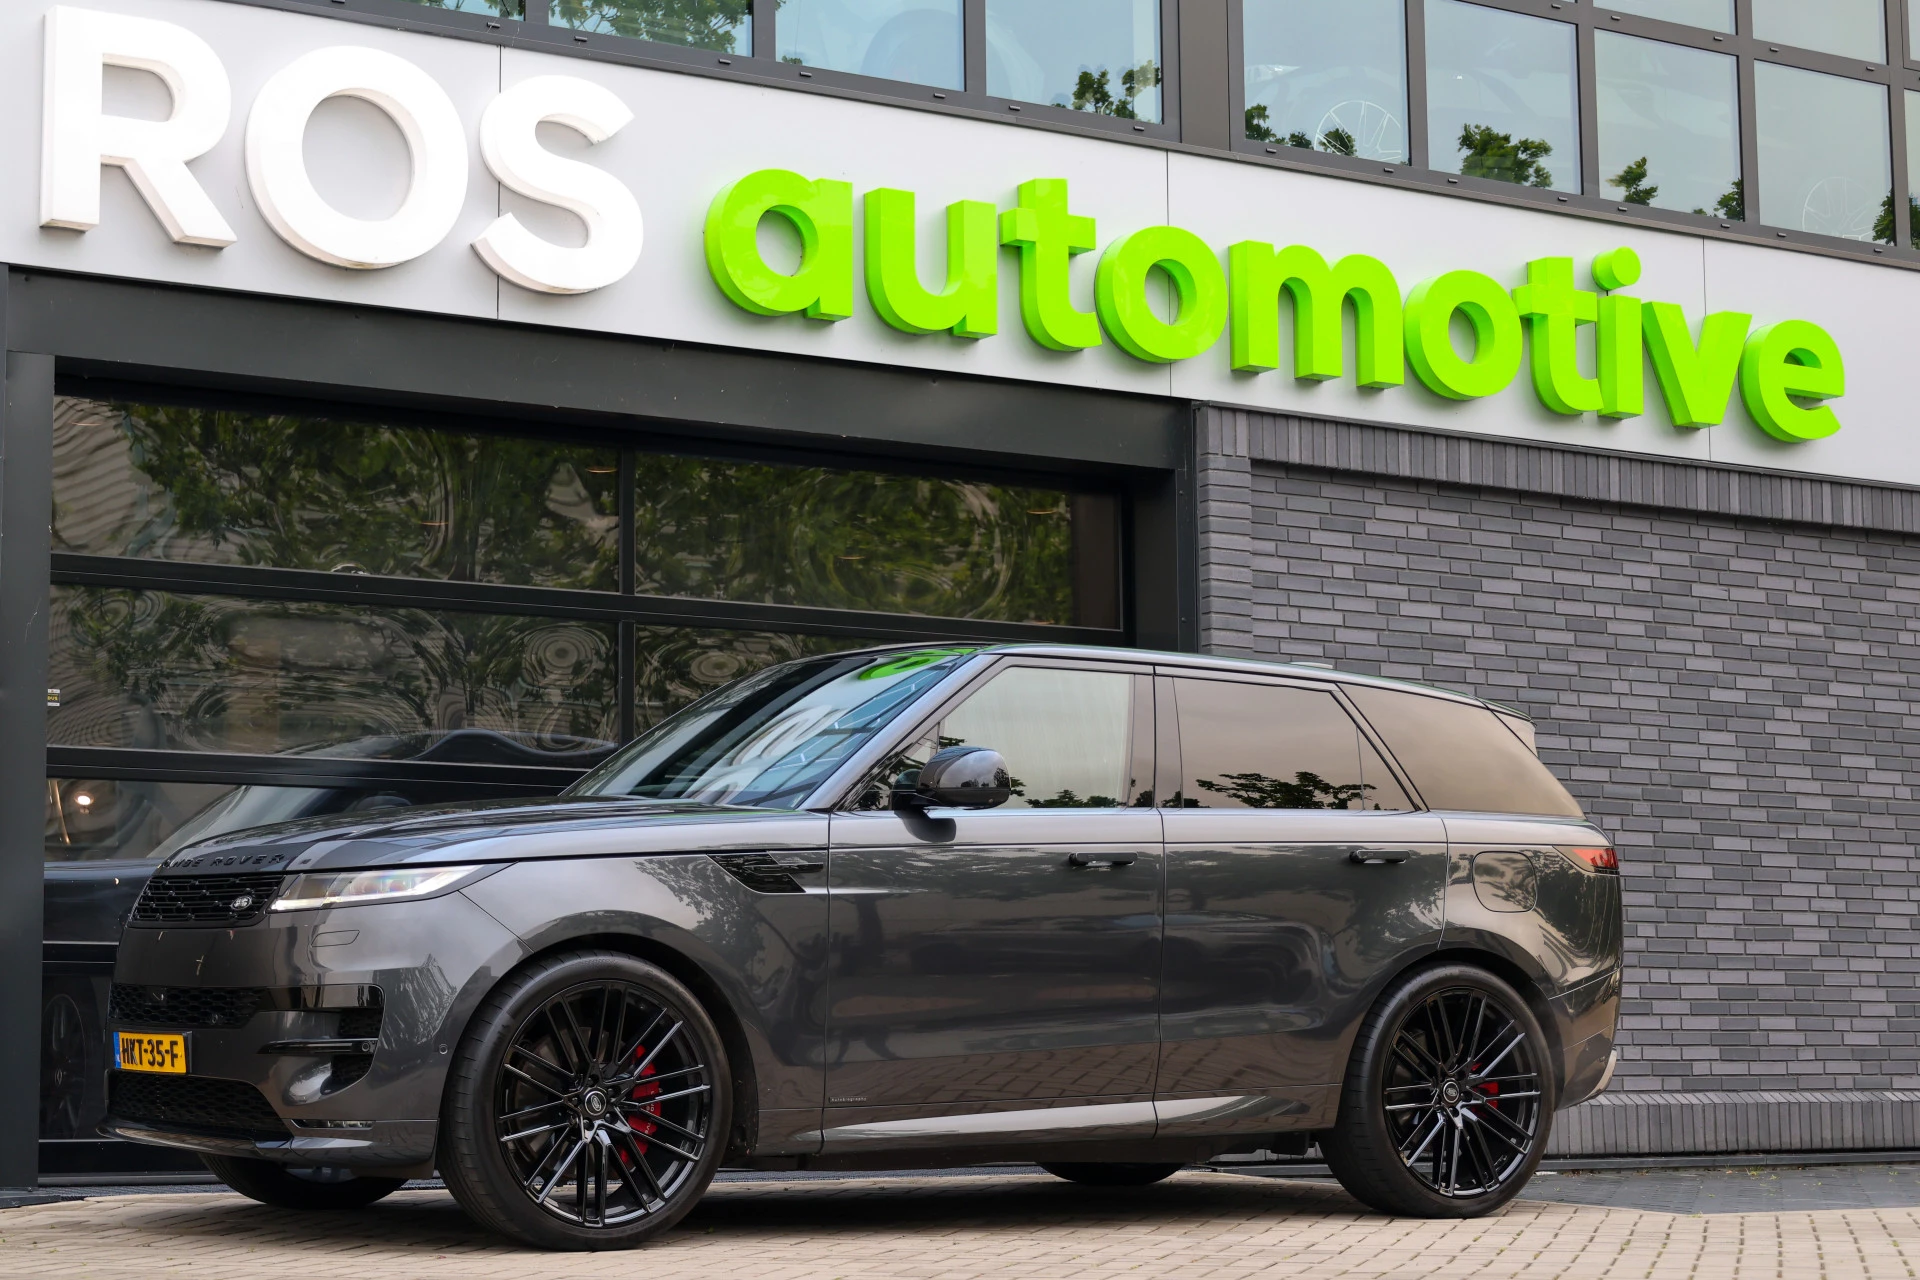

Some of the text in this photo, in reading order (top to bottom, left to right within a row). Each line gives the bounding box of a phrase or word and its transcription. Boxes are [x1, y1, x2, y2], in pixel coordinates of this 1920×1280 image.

[40, 5, 1845, 443] ROS automotive
[210, 854, 285, 866] ROVER
[121, 1037, 179, 1068] HKT-35-F
